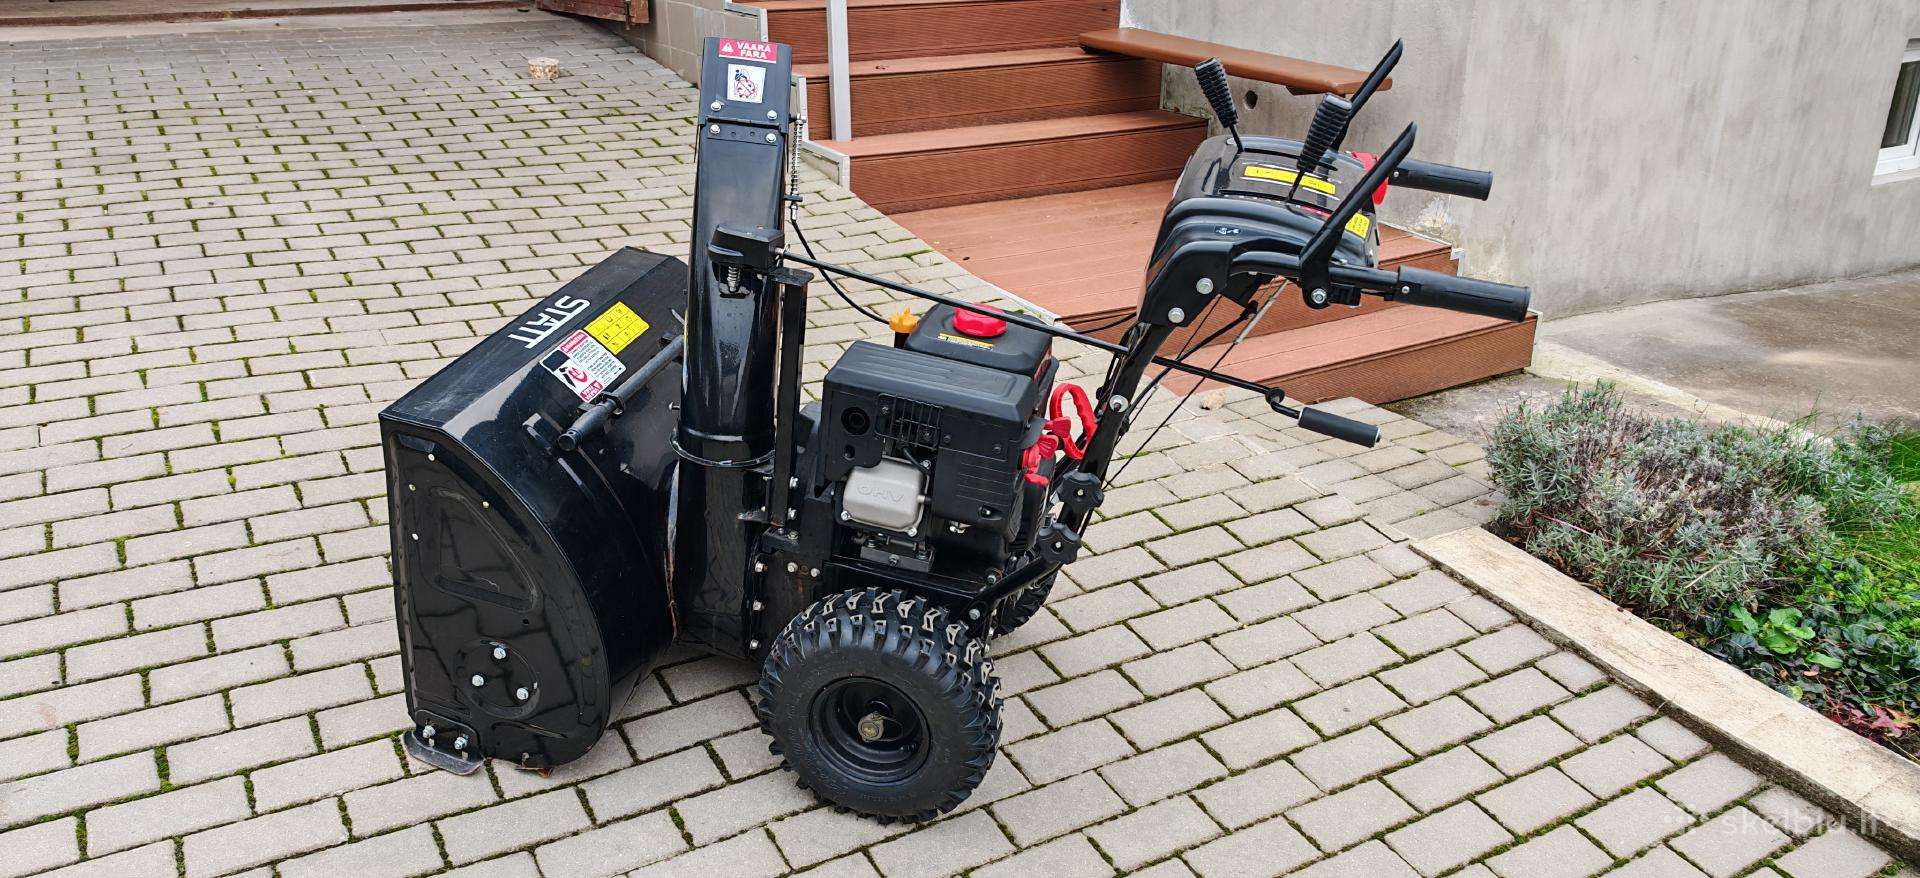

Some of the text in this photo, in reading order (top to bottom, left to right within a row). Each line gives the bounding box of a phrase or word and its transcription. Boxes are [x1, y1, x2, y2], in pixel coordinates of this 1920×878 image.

[737, 41, 771, 52] VAARA
[740, 50, 767, 59] FARA
[507, 295, 591, 349] STATT
[857, 485, 906, 503] OHV
